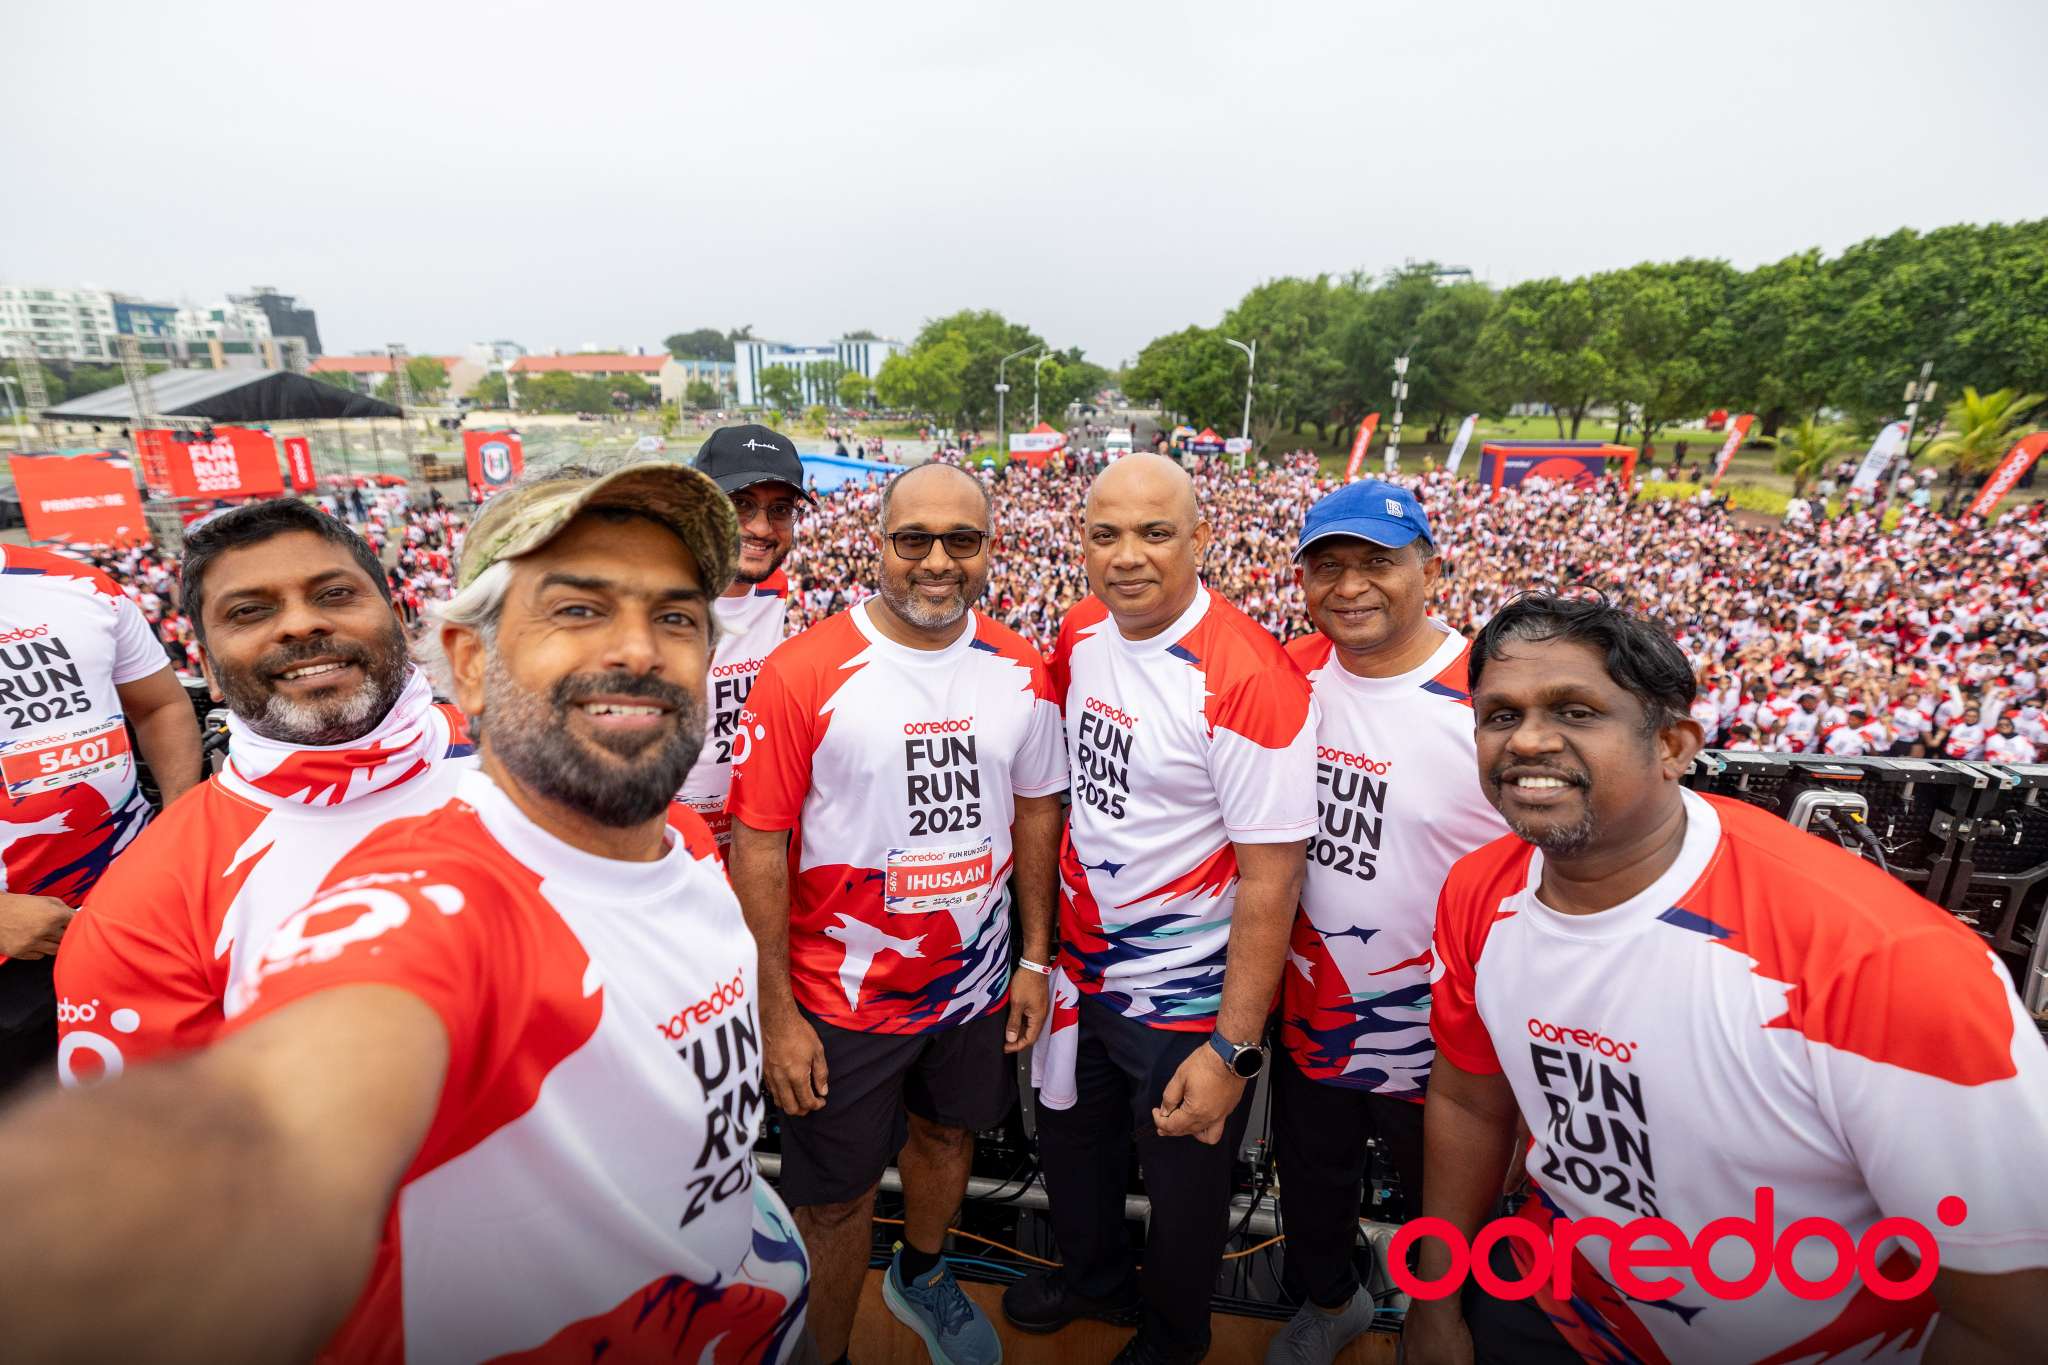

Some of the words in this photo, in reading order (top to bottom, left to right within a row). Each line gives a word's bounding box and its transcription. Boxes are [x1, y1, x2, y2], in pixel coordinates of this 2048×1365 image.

[187, 444, 236, 460] FUN
[192, 460, 239, 477] RUN
[0, 663, 83, 705] RUN
[715, 675, 757, 709] FU
[3, 690, 92, 730] 2025
[904, 716, 974, 735] ooredoo
[1086, 697, 1139, 729] ooredoo
[39, 737, 110, 773] 5407
[905, 735, 978, 771] FUN
[1079, 711, 1133, 765] FUN
[1078, 742, 1131, 794] RUN
[1317, 746, 1392, 776] ooredoo
[907, 769, 981, 806] RUN
[1077, 774, 1127, 820] 2025
[909, 803, 982, 836] 2025
[901, 852, 945, 862] ooredoo
[948, 851, 963, 859] FUN
[963, 848, 976, 857] RUN
[907, 864, 985, 890] IHUSAAN
[1530, 1042, 1648, 1125] FUN
[1544, 1091, 1656, 1183] RUN
